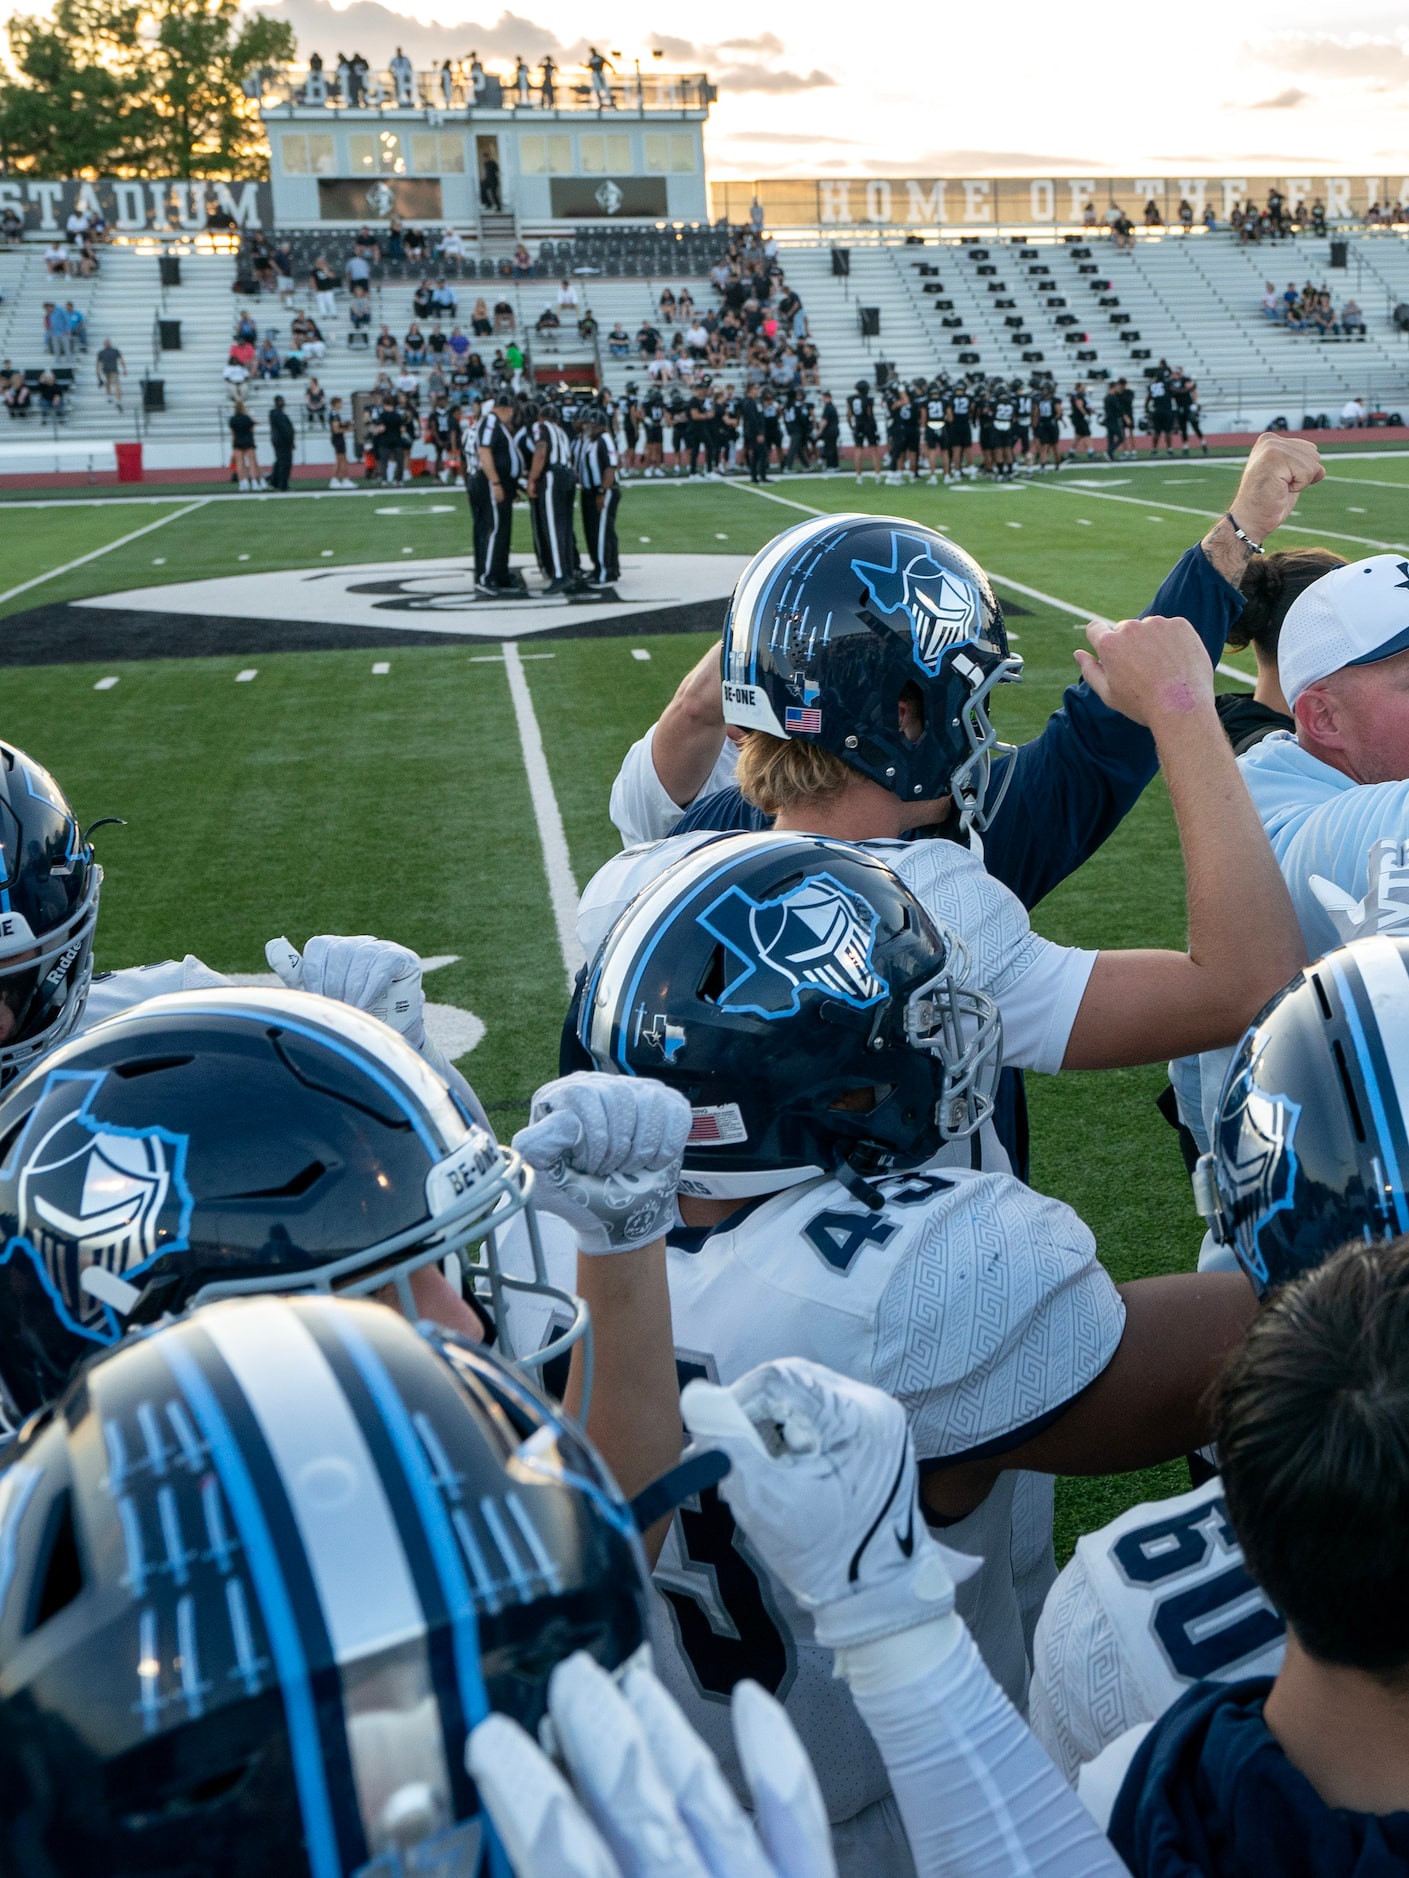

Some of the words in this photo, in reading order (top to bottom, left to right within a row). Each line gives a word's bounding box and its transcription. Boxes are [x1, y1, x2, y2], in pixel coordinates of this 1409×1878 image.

[0, 181, 262, 231] STADIUM
[819, 180, 991, 222] HOME
[1030, 179, 1096, 222] OF
[1135, 178, 1247, 222] THE
[927, 400, 944, 419] 21
[954, 397, 969, 415] 12
[996, 403, 1014, 420] 22
